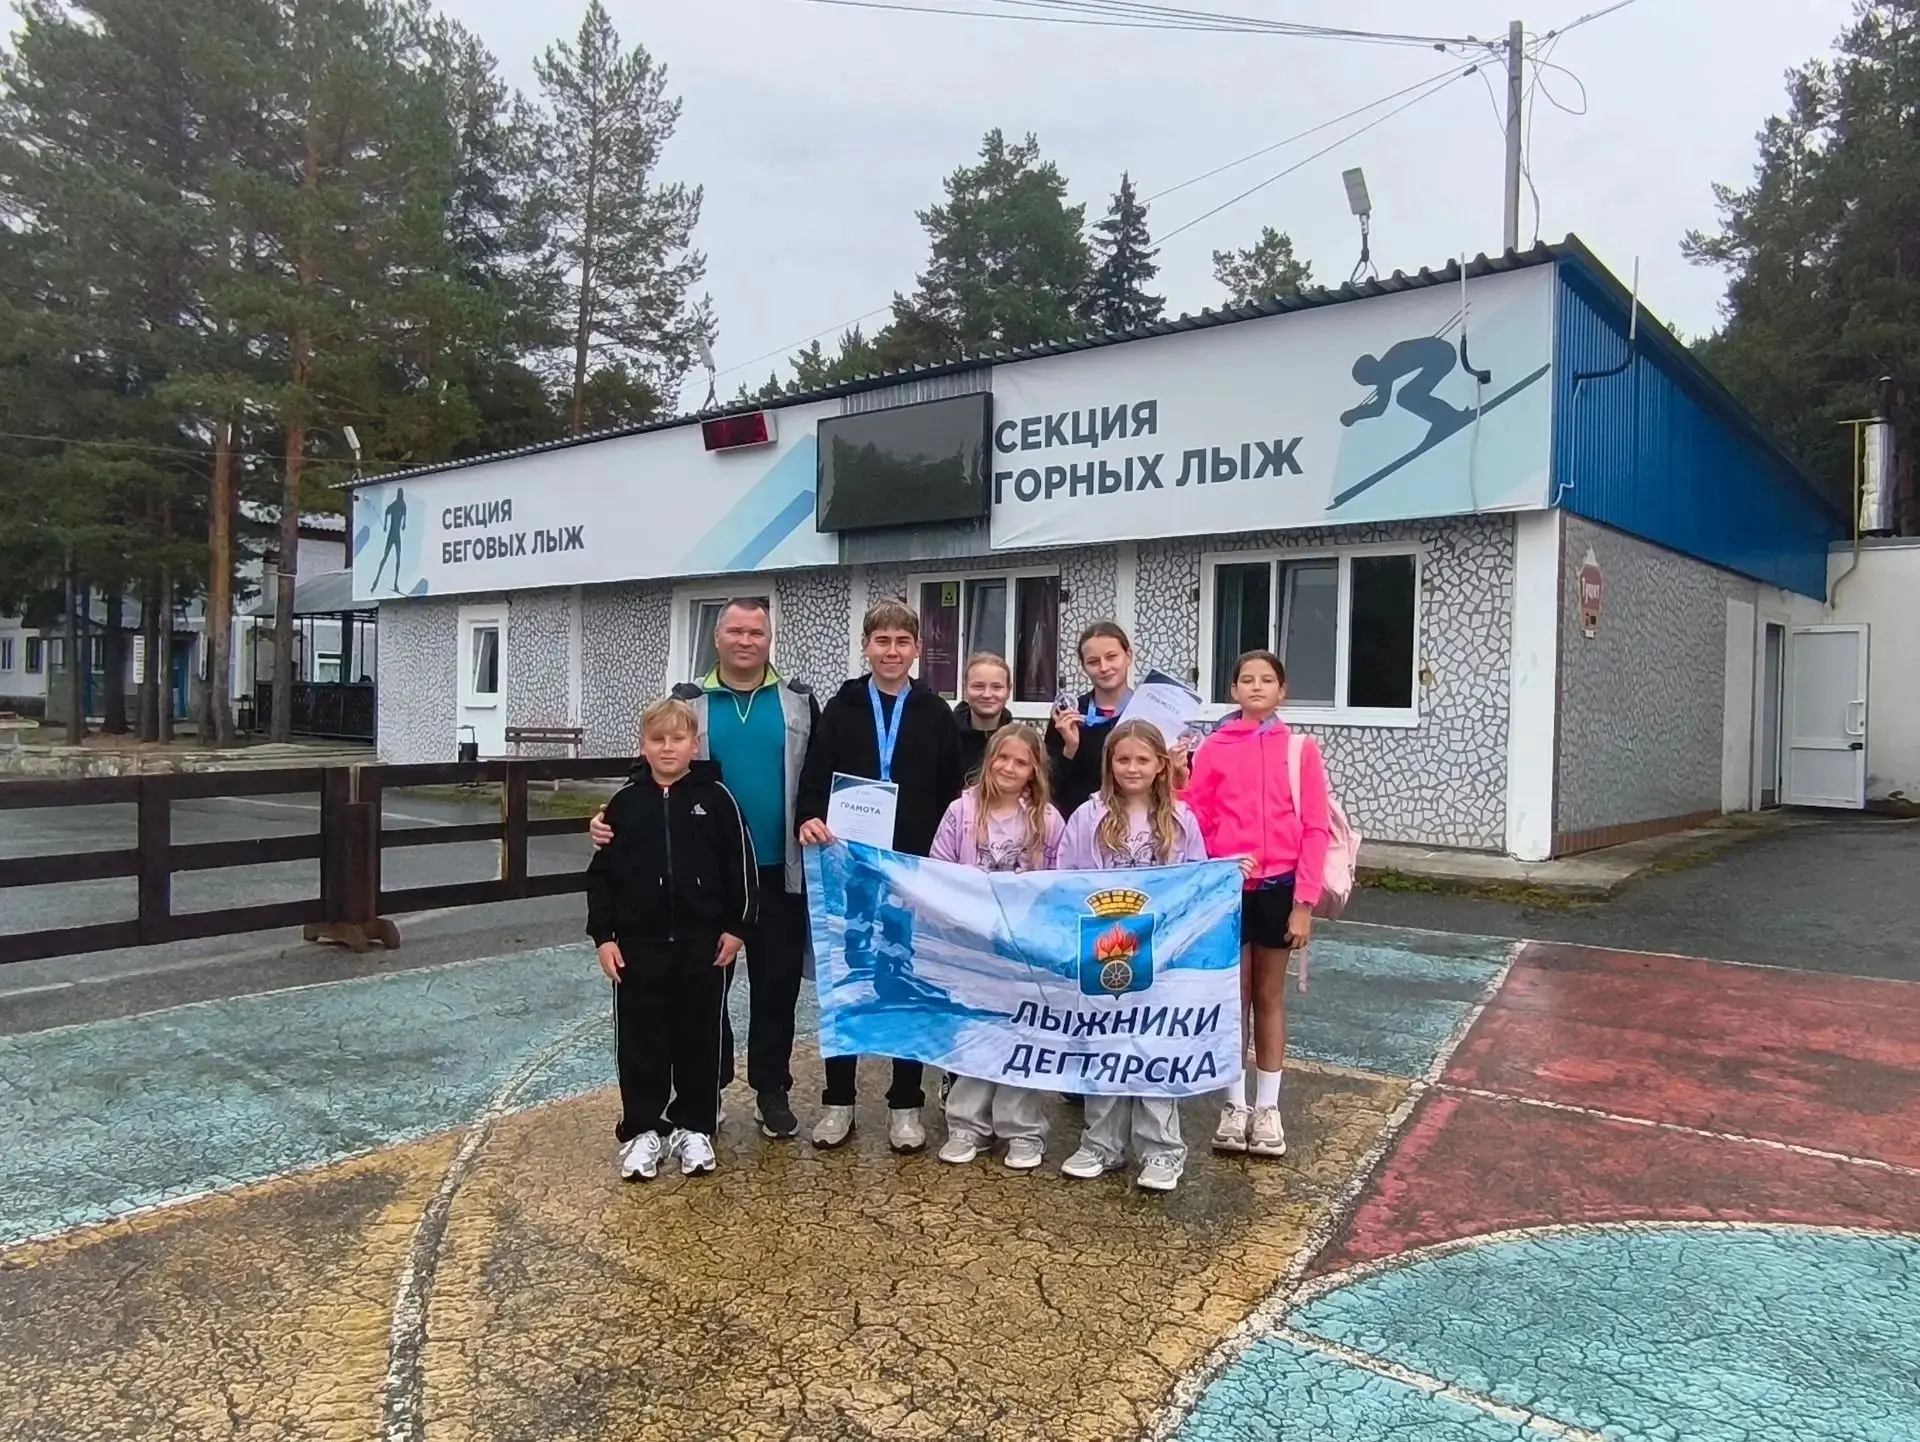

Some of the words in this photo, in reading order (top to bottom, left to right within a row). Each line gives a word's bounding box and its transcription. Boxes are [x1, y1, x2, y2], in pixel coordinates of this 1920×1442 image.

[995, 399, 1158, 454] СЕКЦИЯ
[995, 453, 1165, 505] ГОРНЫХ
[1175, 437, 1304, 487] ЛЫЖ
[442, 499, 512, 530] СЕКЦИЯ
[442, 532, 527, 564] БЕГОВЫХ
[531, 525, 585, 555] ЛЫЖ
[840, 801, 881, 816] ГРАМОТА
[1011, 1000, 1221, 1037] ЛЫЖНИКИ
[1002, 1044, 1218, 1084] ДЕГТЯРСКА
